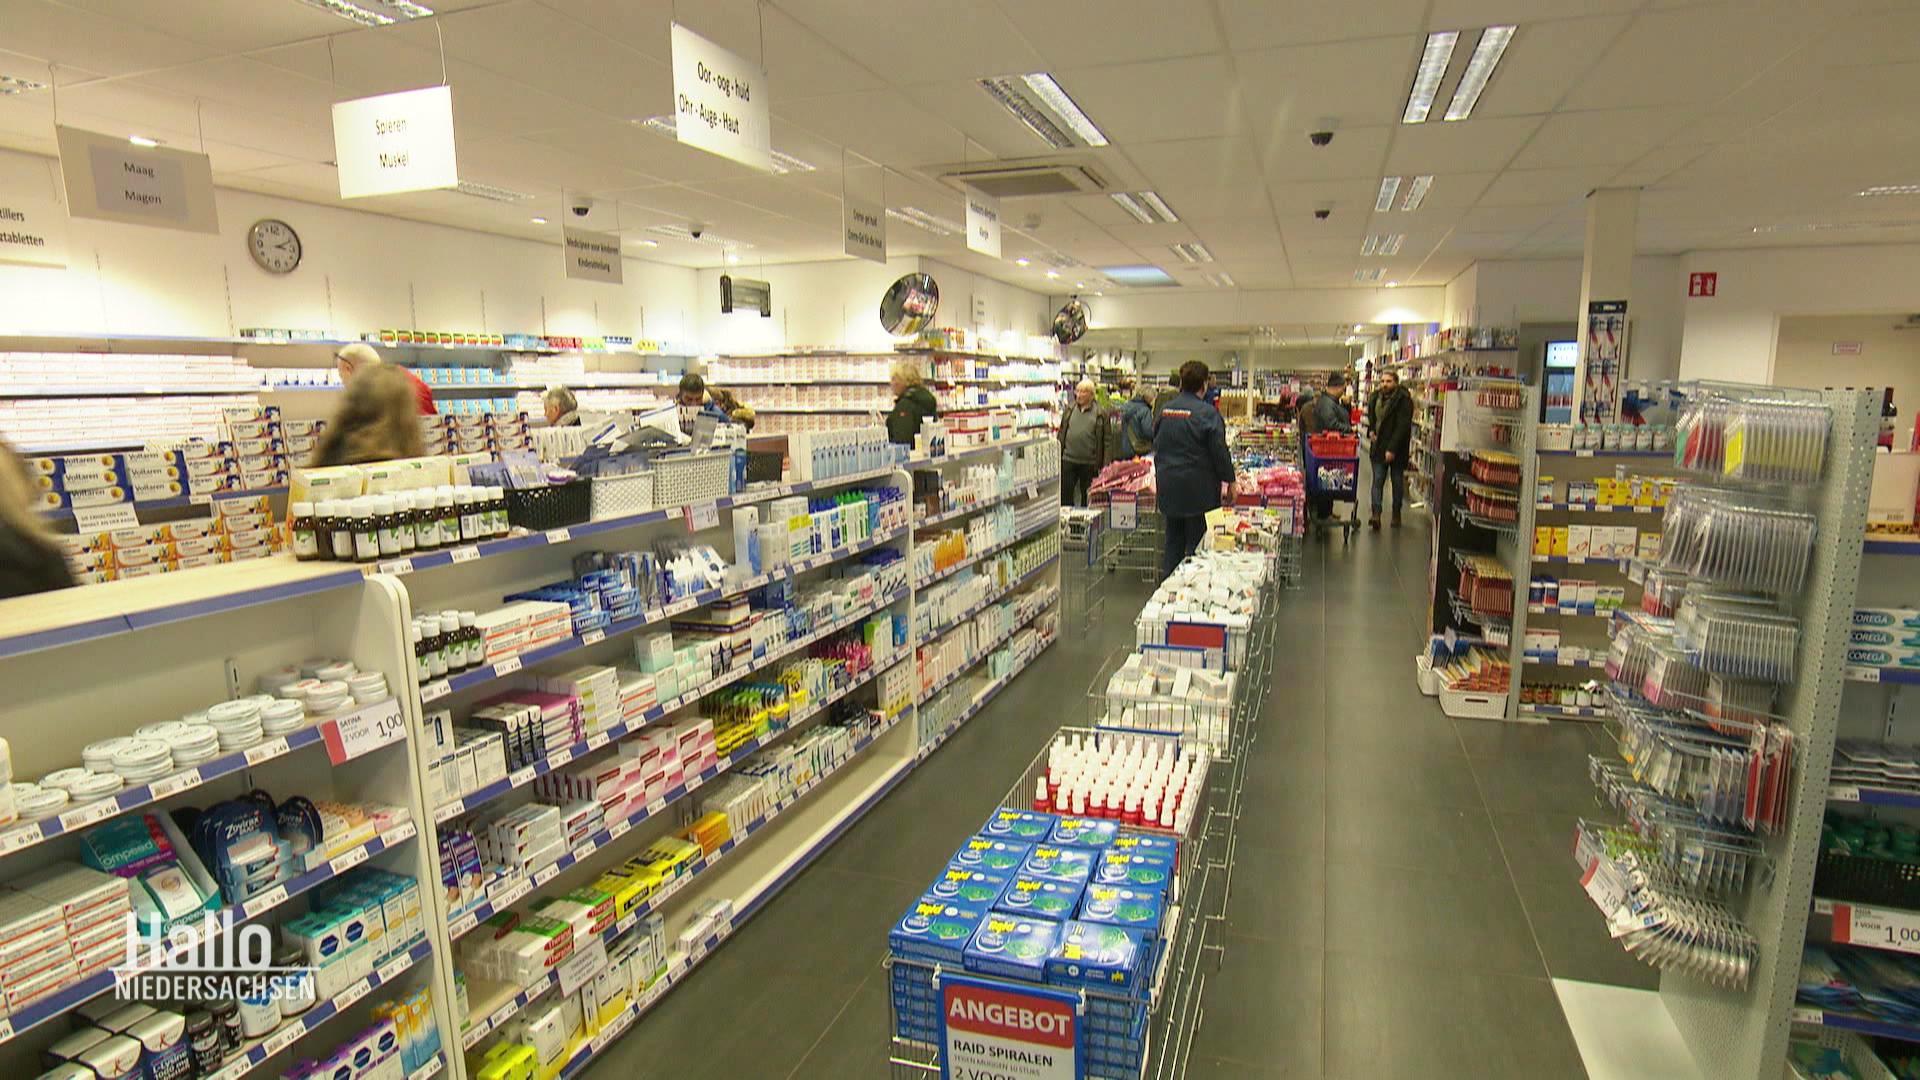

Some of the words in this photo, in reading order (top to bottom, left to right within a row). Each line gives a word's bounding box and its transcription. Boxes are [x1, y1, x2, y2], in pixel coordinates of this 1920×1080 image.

[697, 61, 711, 83] Oor
[717, 75, 731, 98] oog
[735, 79, 750, 101] huid
[679, 93, 693, 115] Ohr
[699, 103, 718, 128] Auge
[722, 111, 740, 135] Haut
[375, 118, 408, 138] Spieren
[124, 161, 155, 178] Maag
[378, 150, 410, 169] Muskel
[124, 190, 162, 205] Magen
[66, 473, 99, 481] Voltaren
[376, 712, 403, 738] 1,00
[1884, 925, 1920, 947] 1,00
[949, 997, 1070, 1037] ANGEBOT
[953, 1040, 986, 1055] RAID
[988, 1045, 1053, 1067] SPIRALEN
[954, 1065, 964, 1080] 2
